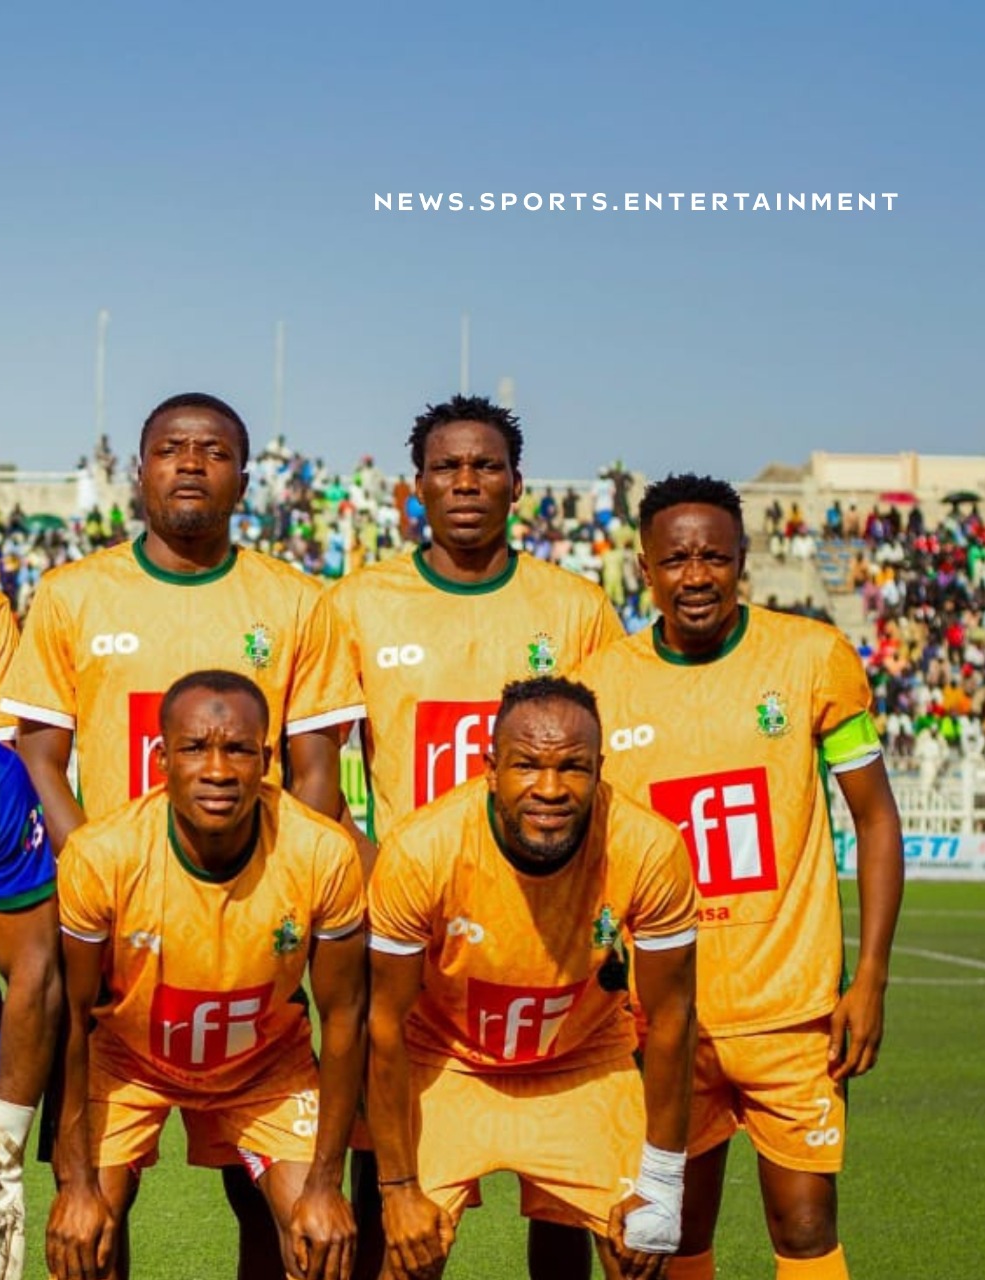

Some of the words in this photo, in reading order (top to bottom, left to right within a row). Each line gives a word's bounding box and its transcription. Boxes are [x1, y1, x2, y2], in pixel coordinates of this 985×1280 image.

[91, 632, 139, 656] ao
[377, 644, 424, 669] ao
[610, 724, 655, 751] ao
[163, 997, 261, 1064] rfi
[479, 994, 575, 1060] rfi
